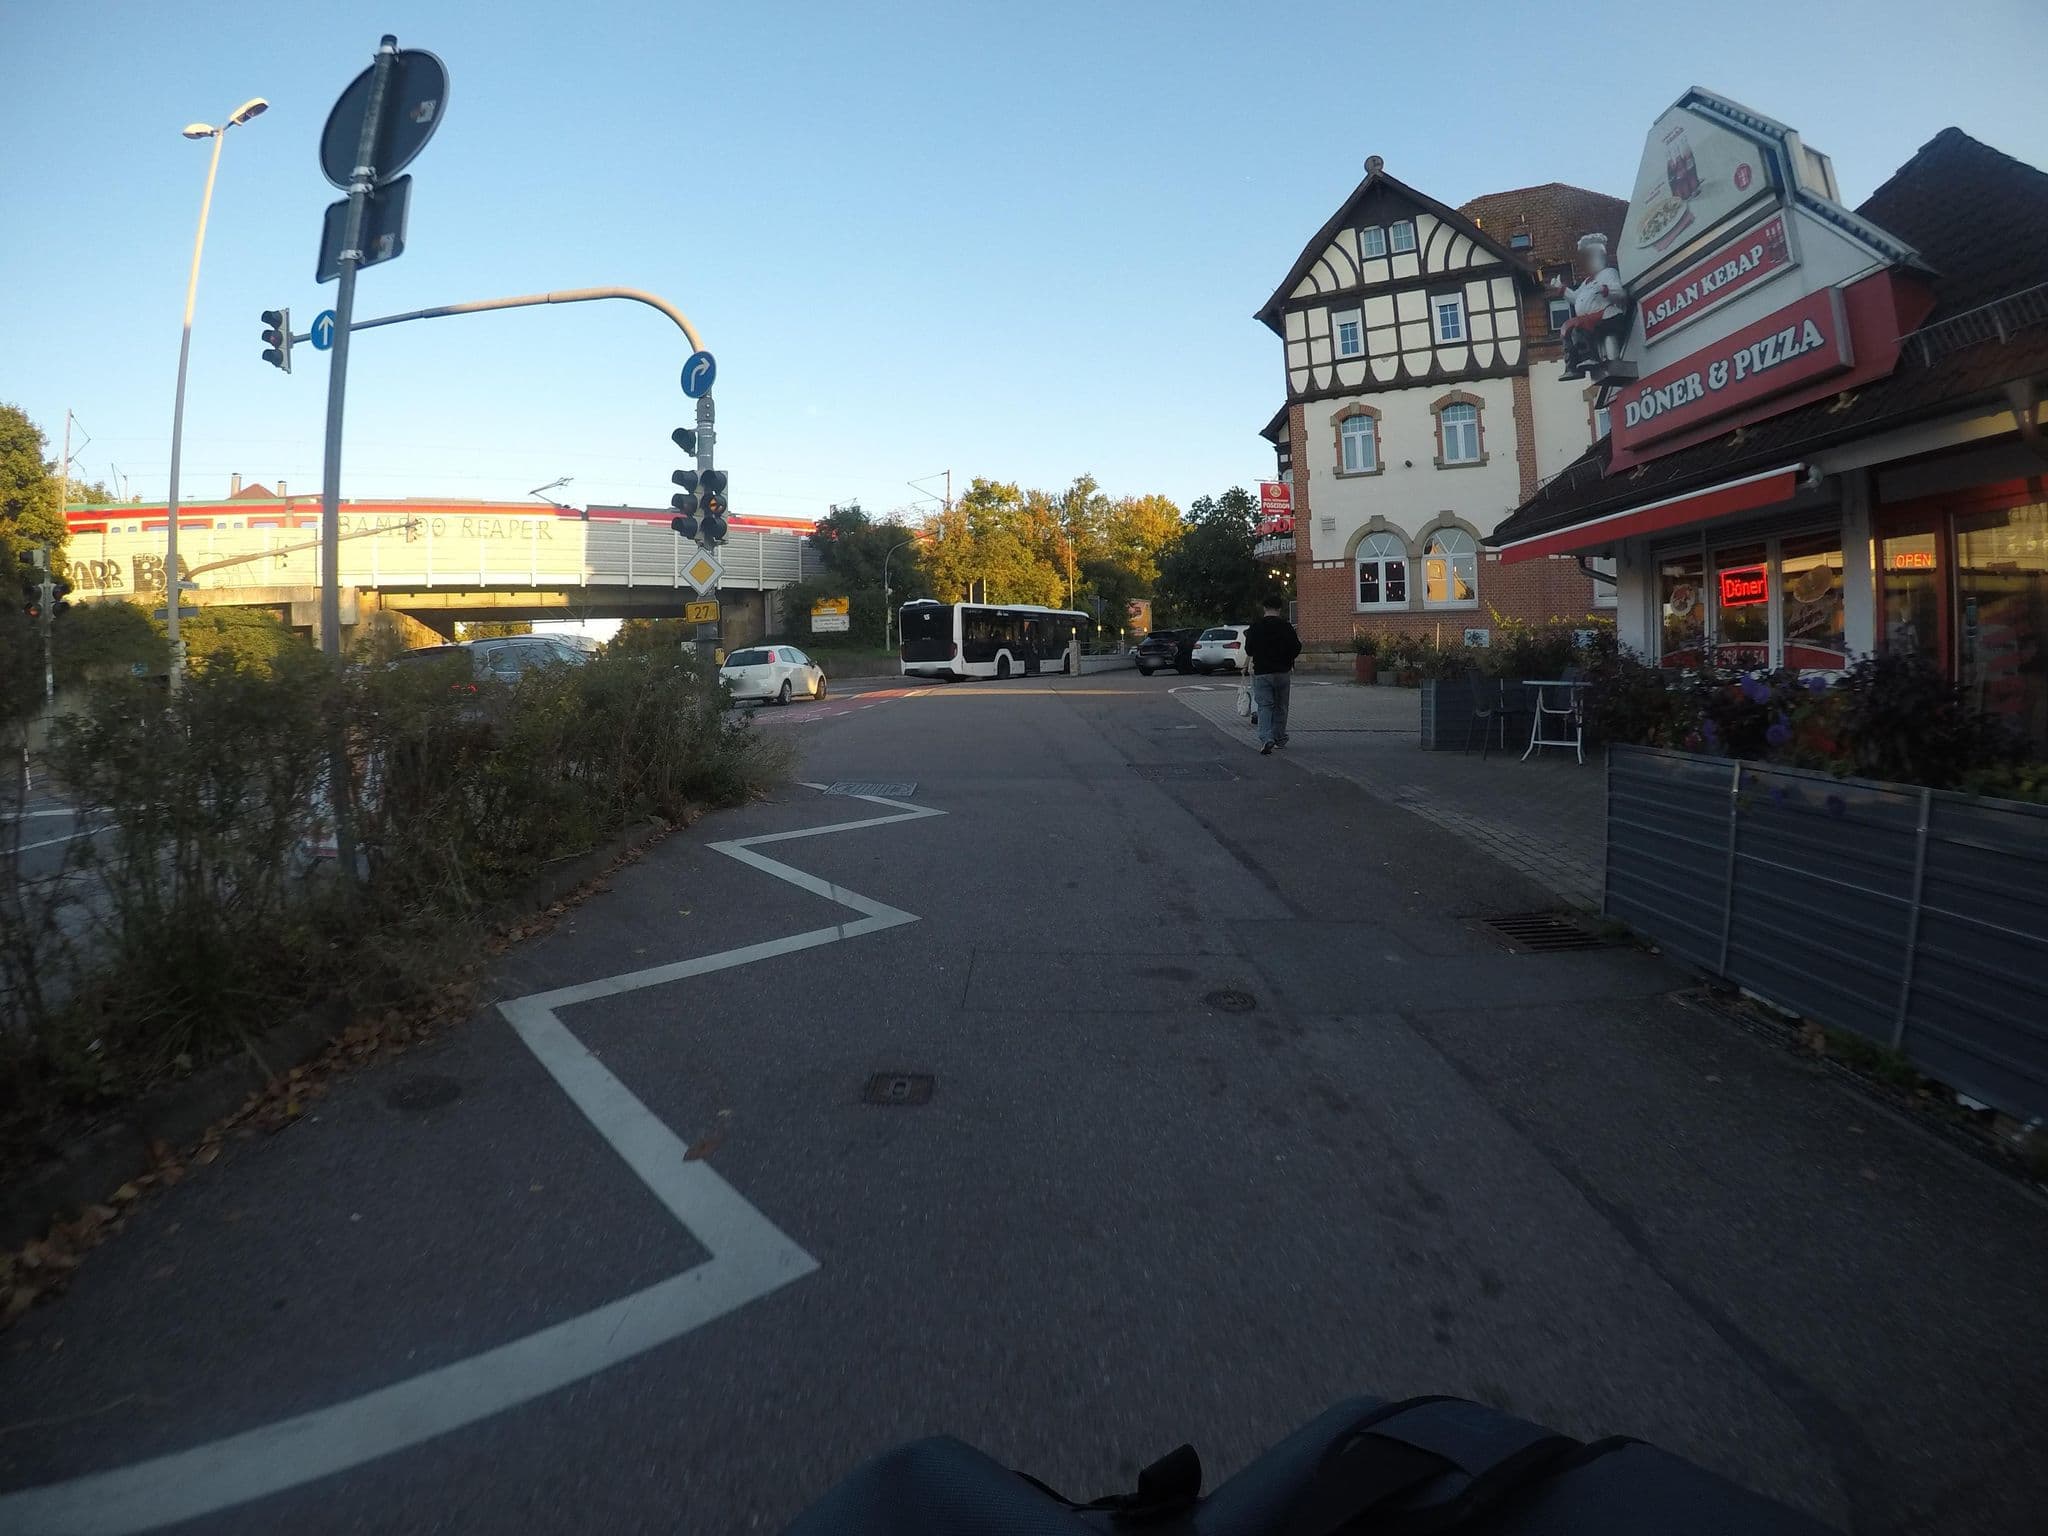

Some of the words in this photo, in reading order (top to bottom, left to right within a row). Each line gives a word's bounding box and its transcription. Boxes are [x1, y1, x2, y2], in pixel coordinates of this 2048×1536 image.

[1646, 285, 1699, 328] ASLAN
[1701, 244, 1764, 296] KEBAP
[1625, 373, 1704, 427] DÖNER
[1708, 360, 1729, 390] &
[1733, 319, 1825, 380] PIZZA
[1263, 501, 1290, 510] POSEIDON
[462, 517, 553, 540] REAPER
[1895, 553, 1932, 568] OPEN
[1725, 578, 1764, 598] Döner
[694, 605, 710, 620] 27
